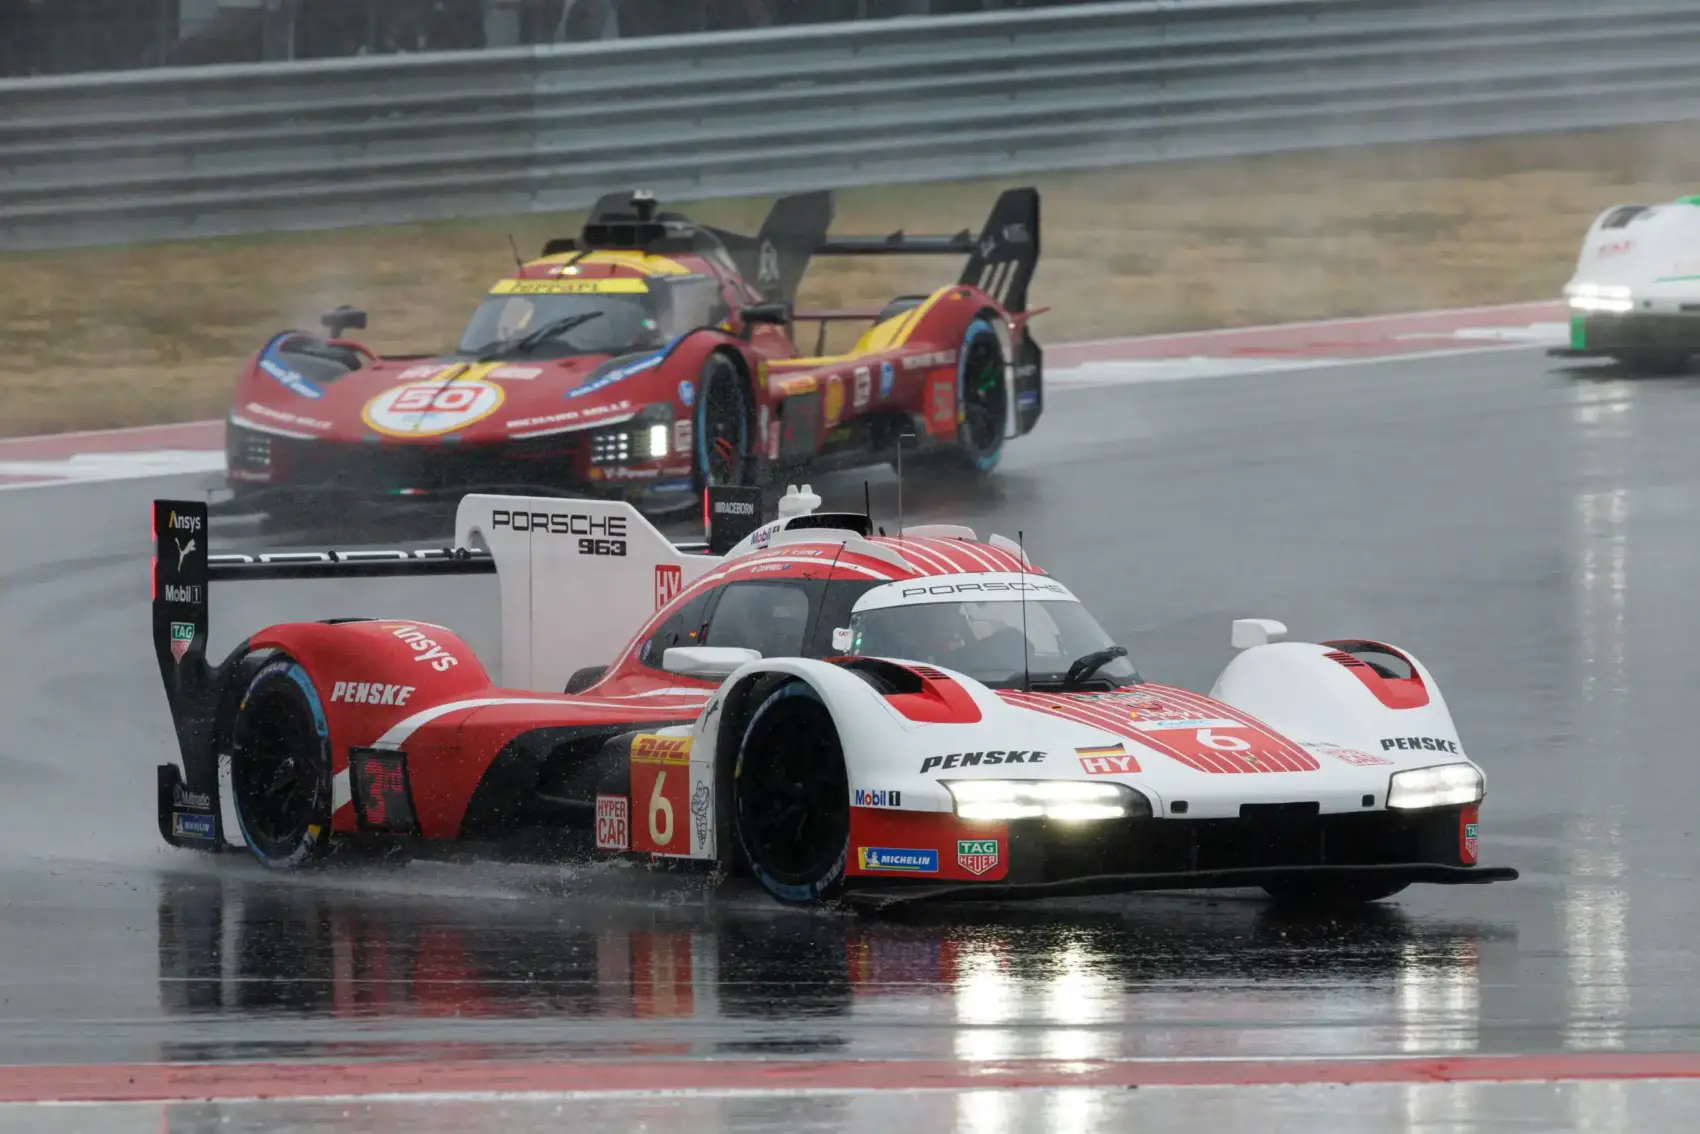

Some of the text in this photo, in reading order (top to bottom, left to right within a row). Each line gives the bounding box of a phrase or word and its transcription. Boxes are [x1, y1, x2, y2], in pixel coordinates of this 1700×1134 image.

[395, 389, 475, 410] 50
[720, 502, 754, 514] RACEBORN
[169, 510, 201, 532] Ansys
[492, 510, 627, 537] PORSCHE
[750, 529, 772, 545] Mobil
[578, 539, 626, 556] 963
[165, 585, 191, 602] Mobil
[657, 570, 680, 612] HY
[902, 583, 1067, 598] PORSCHE
[173, 625, 193, 638] TAG
[382, 625, 459, 672] Ansys
[330, 681, 416, 706] PENSKE
[637, 738, 687, 758] DHL
[1196, 728, 1251, 750] 6
[1380, 737, 1459, 755] PENSKE
[919, 751, 1048, 774] PENSKE
[1081, 757, 1131, 773] HY
[855, 790, 900, 806] Mobil 1
[598, 799, 626, 817] HYPER
[649, 770, 674, 846] 6
[598, 818, 626, 845] CAR
[961, 842, 994, 853] TAG
[880, 855, 931, 865] MICHELIN
[959, 855, 996, 872] HEUER
